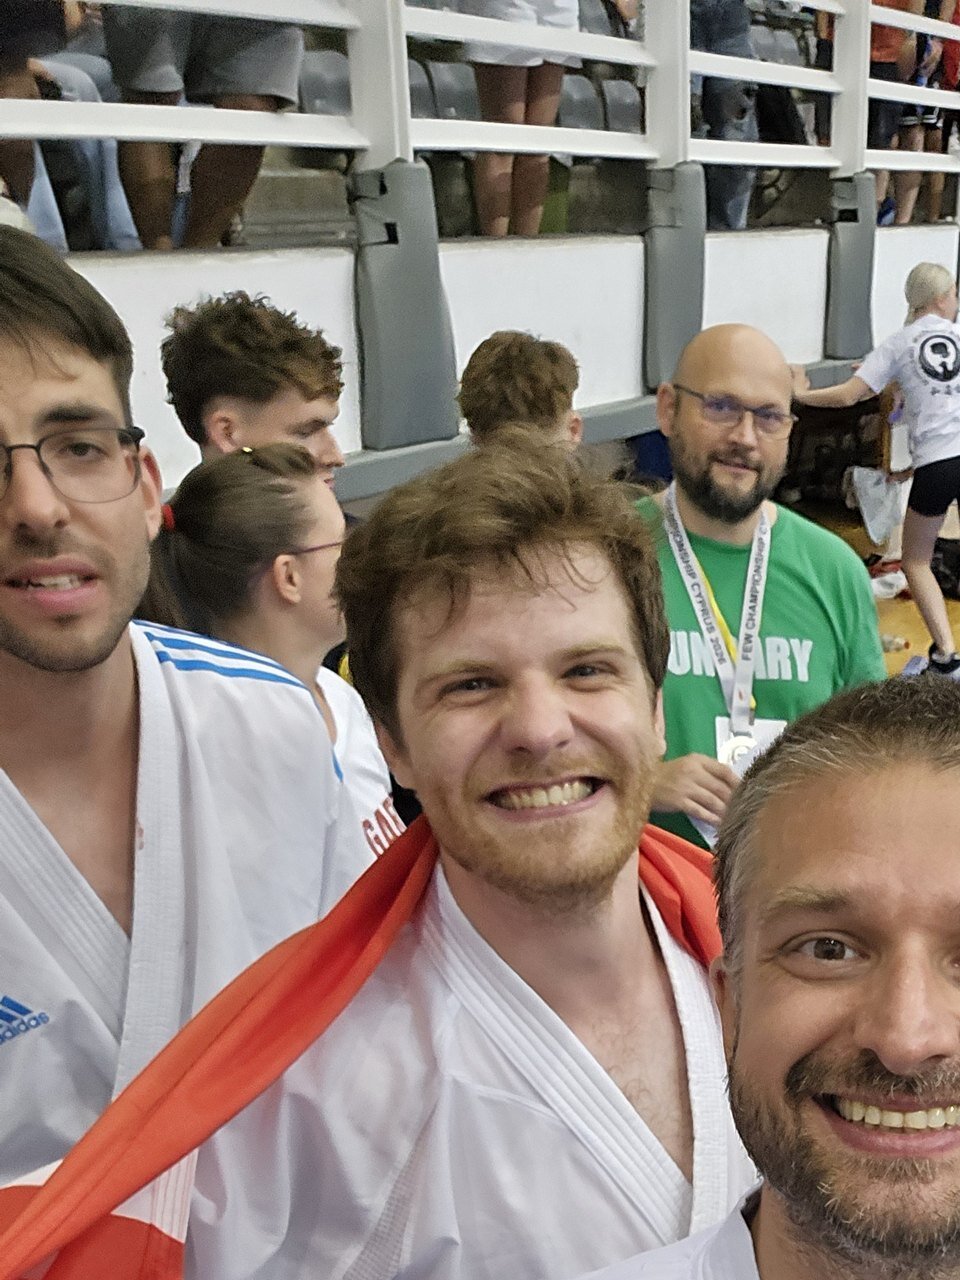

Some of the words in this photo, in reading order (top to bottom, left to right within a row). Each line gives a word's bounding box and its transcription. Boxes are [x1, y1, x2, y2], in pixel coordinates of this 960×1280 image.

[691, 582, 716, 634] CYPRUS
[745, 537, 766, 631] CHAMPIONSHIP
[668, 631, 813, 682] UNARY
[741, 633, 753, 661] FEW
